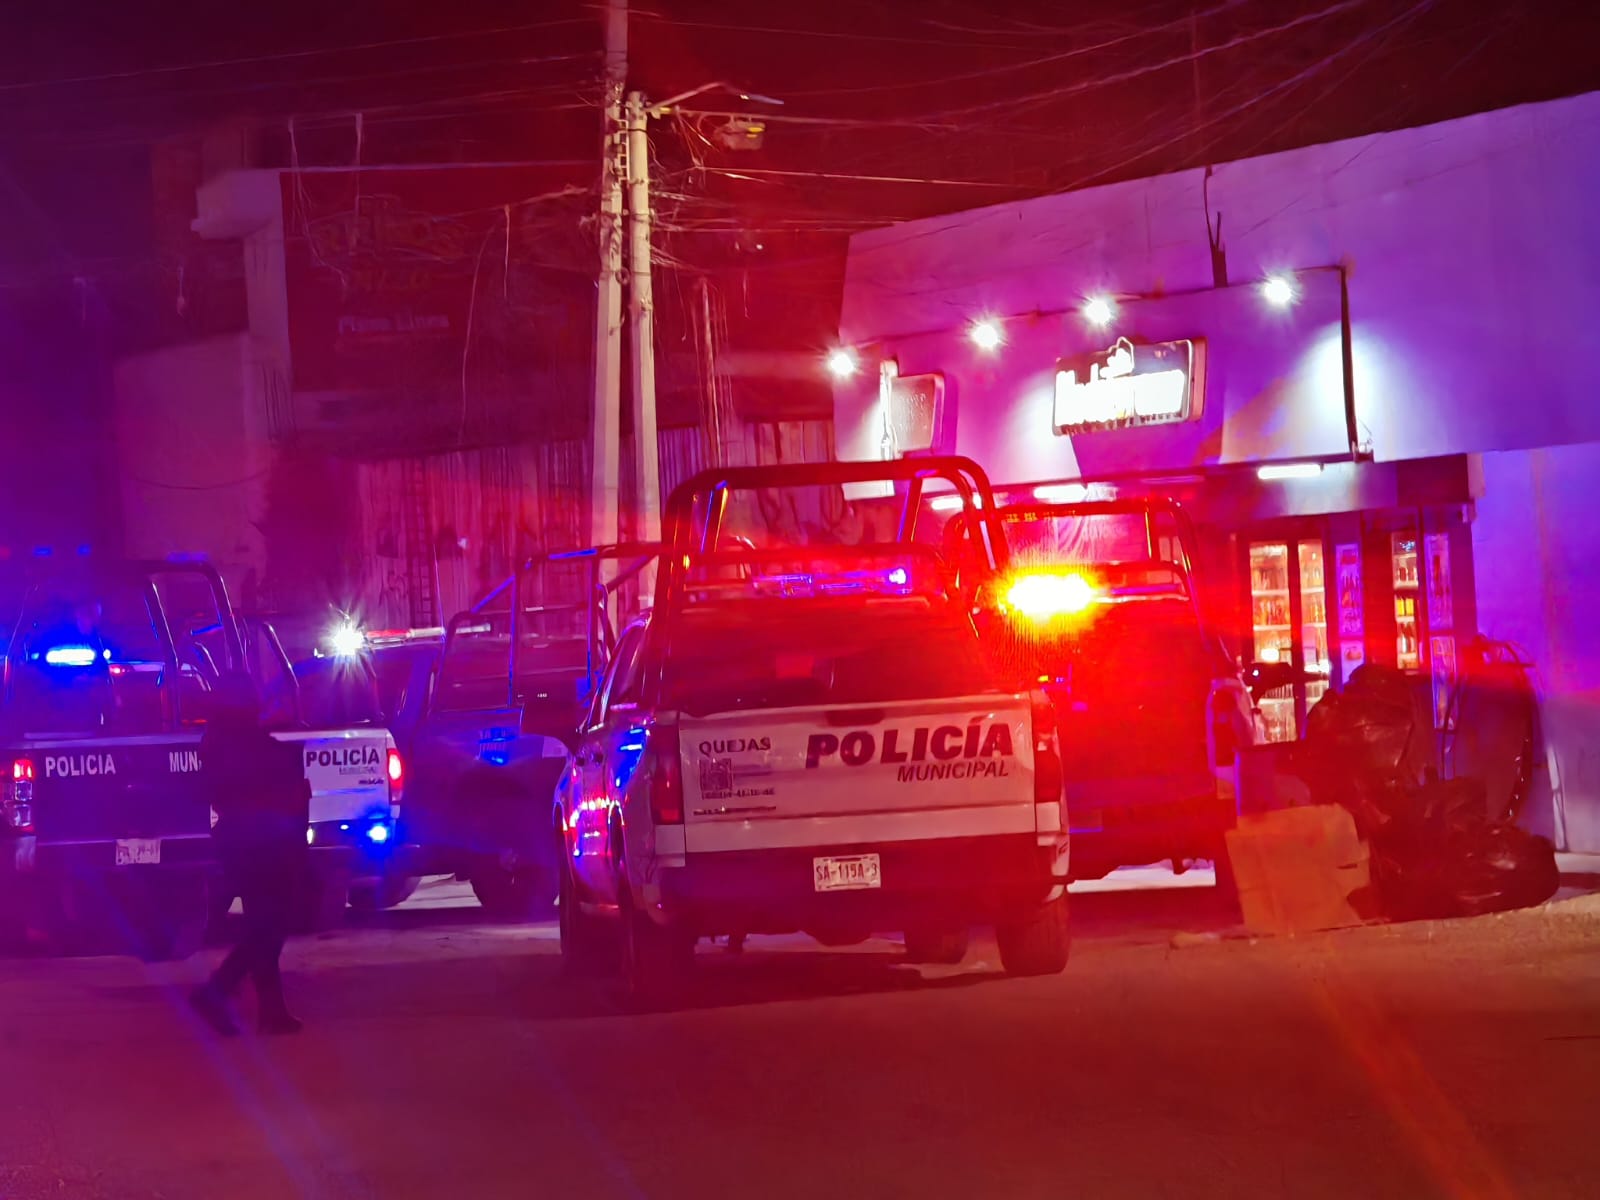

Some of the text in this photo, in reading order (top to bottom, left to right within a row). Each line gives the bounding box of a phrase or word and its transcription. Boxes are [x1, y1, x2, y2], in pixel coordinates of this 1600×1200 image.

[698, 737, 771, 758] QUEJAS
[805, 714, 1013, 769] POLICÍA
[45, 753, 117, 778] POLICIA
[306, 745, 380, 768] POLICÍA
[897, 761, 1010, 783] MUNICIPAL
